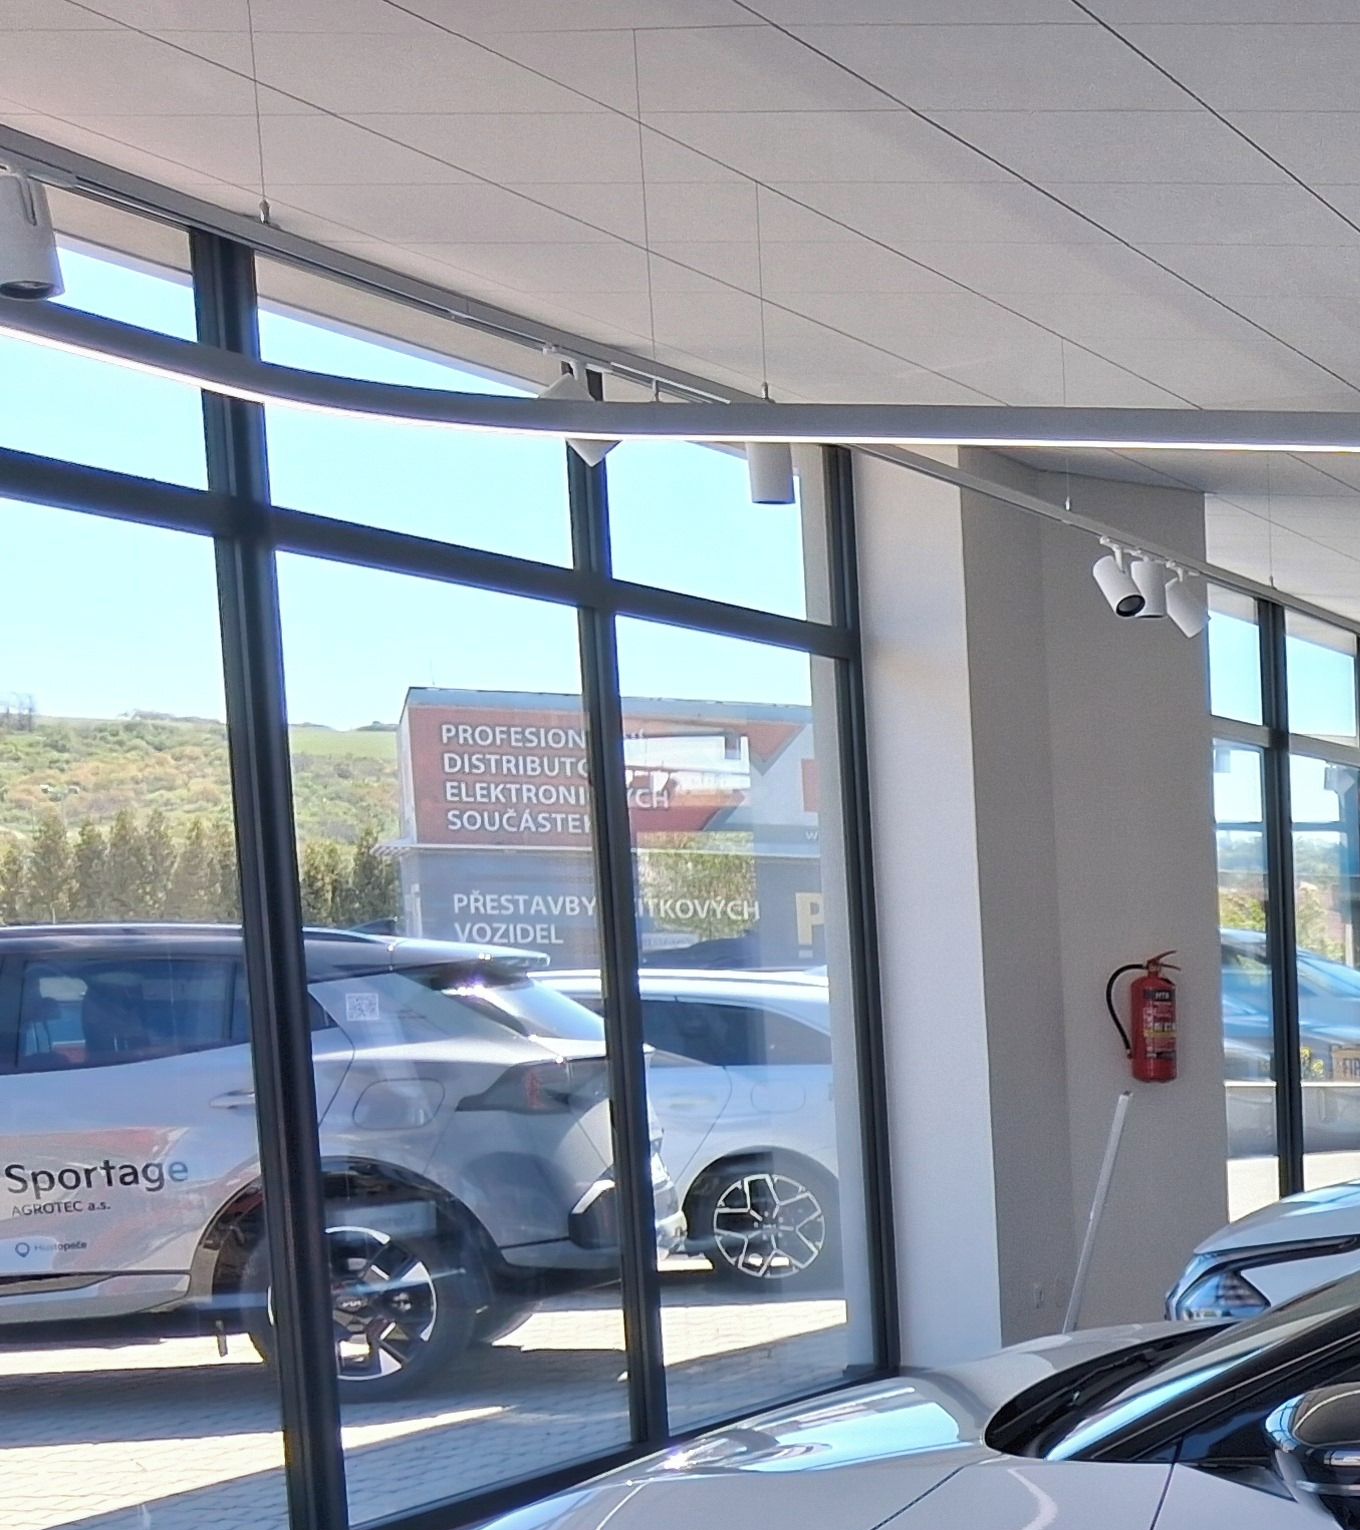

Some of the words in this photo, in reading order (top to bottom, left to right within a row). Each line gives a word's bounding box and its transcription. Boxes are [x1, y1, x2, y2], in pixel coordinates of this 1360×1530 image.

[441, 724, 588, 749] PROFESION
[443, 753, 590, 778] DISTRIBUTO
[453, 890, 597, 917] PŘESTAVBY
[634, 896, 761, 921] ITKOVÝCH
[454, 922, 565, 944] VOZIDEL
[4, 1160, 188, 1199] Sportage
[12, 1201, 83, 1216] AGROTEC
[87, 1201, 111, 1212] a.s.
